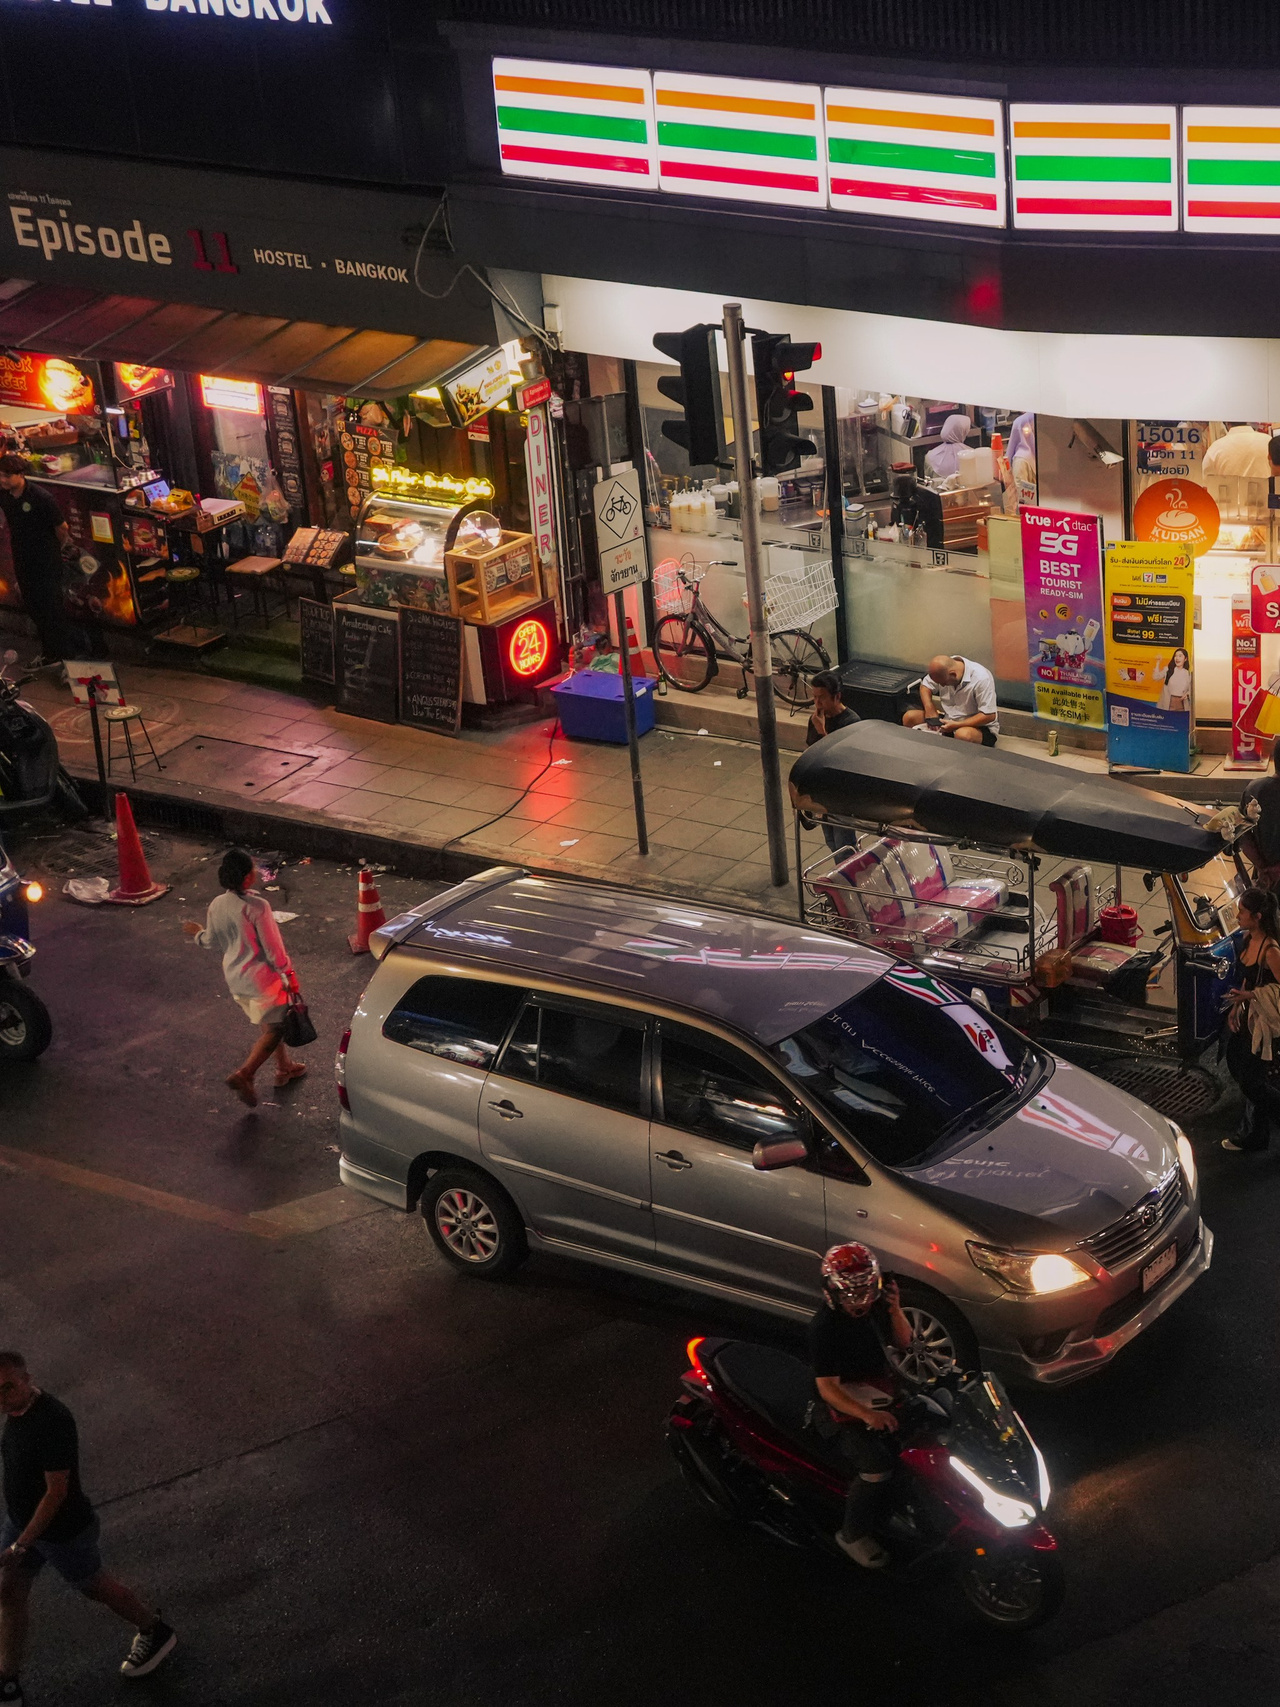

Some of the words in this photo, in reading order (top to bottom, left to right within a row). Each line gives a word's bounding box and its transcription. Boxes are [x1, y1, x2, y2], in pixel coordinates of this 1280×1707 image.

[9, 205, 173, 266] Episode
[186, 229, 239, 275] 11
[253, 248, 313, 270] HOSTEL
[334, 258, 410, 284] BANGKOK
[1137, 427, 1201, 444] 15016
[1181, 450, 1196, 460] 11
[530, 414, 551, 555] DINER
[1024, 512, 1052, 527] true
[1071, 520, 1093, 532] dtac
[1150, 525, 1206, 541] KUDSAN
[1039, 531, 1079, 557] 5G
[1039, 559, 1082, 578] BEST
[1174, 556, 1185, 566] 24
[610, 564, 639, 583] จักรยาน
[1039, 576, 1083, 590] TOURIST
[1040, 587, 1084, 600] READY-SIM
[519, 623, 536, 638] OPEN
[519, 633, 541, 658] 24
[1236, 637, 1257, 648] No.1
[519, 652, 541, 670] HOURS
[1037, 685, 1050, 694] SIM
[1051, 688, 1081, 699] Available
[1082, 693, 1100, 701] Here
